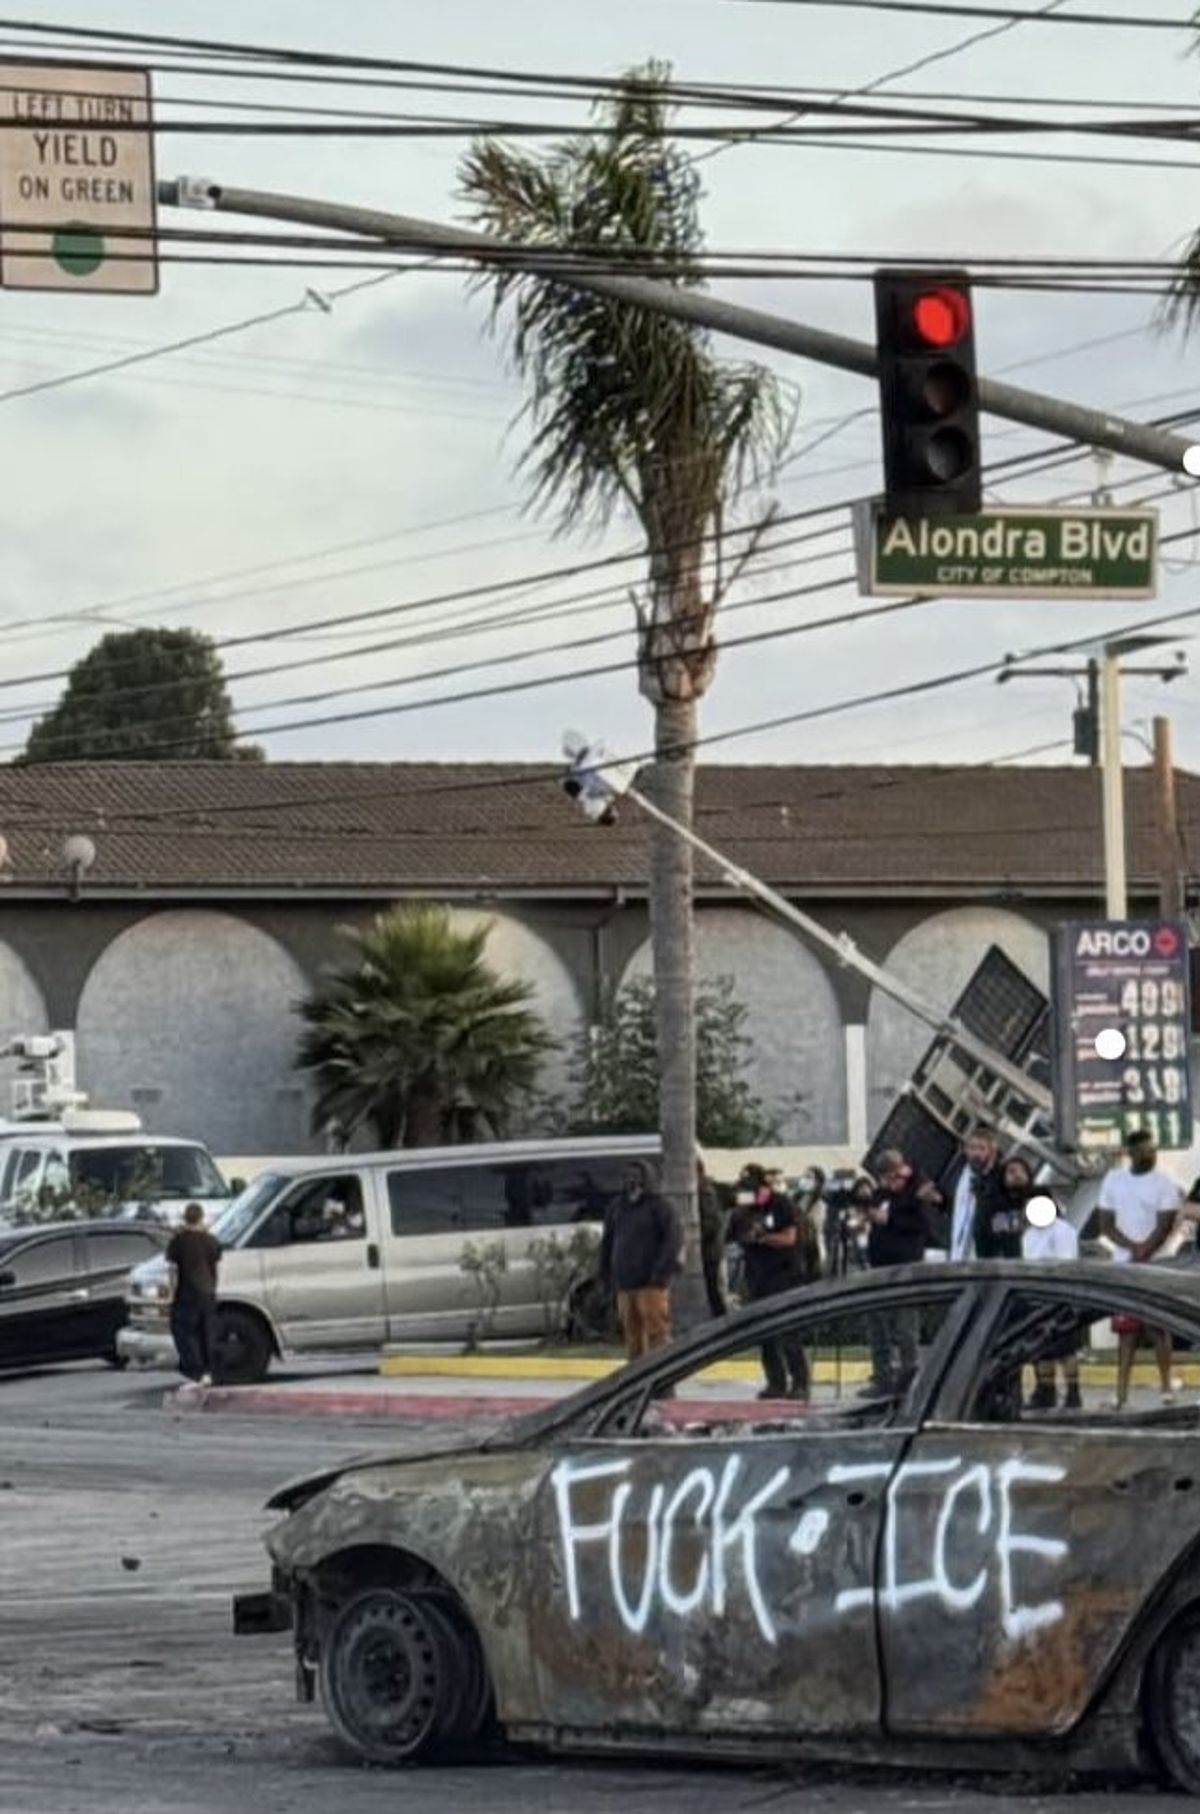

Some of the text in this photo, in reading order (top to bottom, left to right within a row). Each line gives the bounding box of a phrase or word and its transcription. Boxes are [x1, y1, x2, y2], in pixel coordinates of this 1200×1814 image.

[77, 96, 134, 122] TURN
[33, 132, 118, 167] YIELD
[19, 175, 134, 203] ON GREEN
[882, 518, 1149, 561] Alondra Blvd
[937, 566, 1093, 584] CITY OF COMPTON
[1076, 929, 1151, 957] ARCO
[551, 1450, 1068, 1646] FUCK ICE
